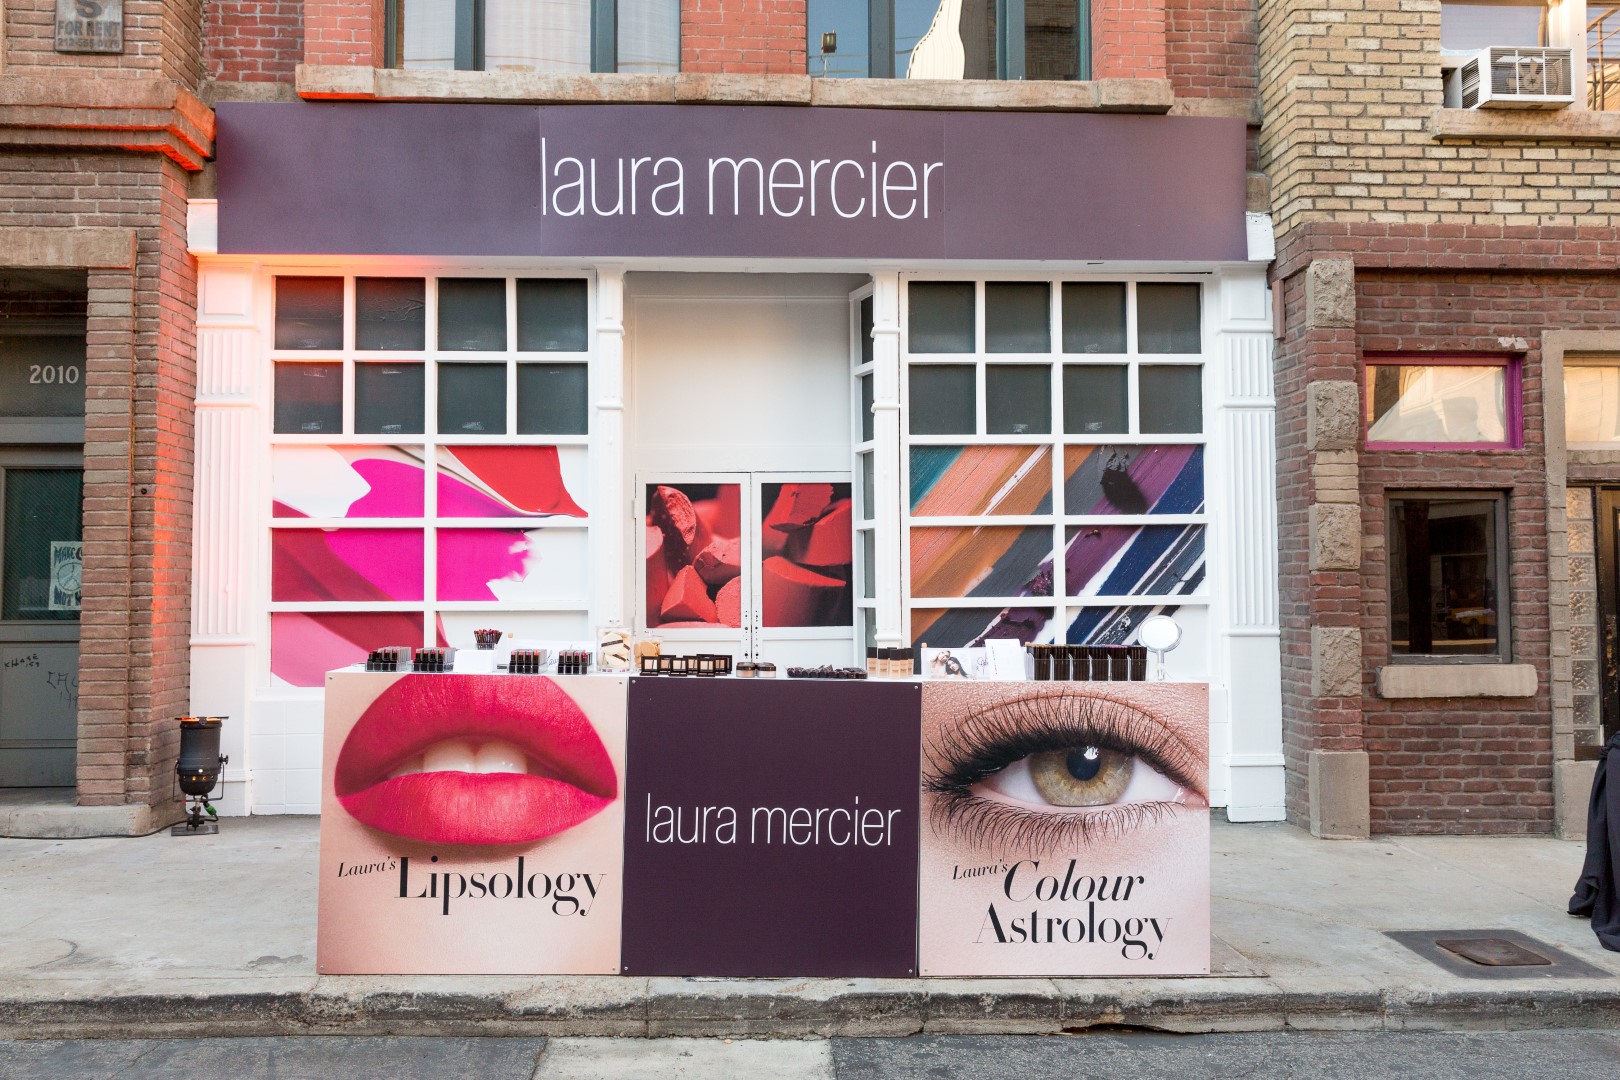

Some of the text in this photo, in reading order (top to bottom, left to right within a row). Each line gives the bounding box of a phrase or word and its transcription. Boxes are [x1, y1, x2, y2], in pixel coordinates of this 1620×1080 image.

[57, 20, 121, 37] FOR RENT
[541, 137, 944, 220] laura mercier
[29, 364, 80, 384] 2010
[646, 792, 902, 846] laura mercier
[337, 855, 608, 917] Laura's Lipsology
[952, 858, 1145, 902] Laura's Colour
[971, 901, 1174, 961] Astrology
